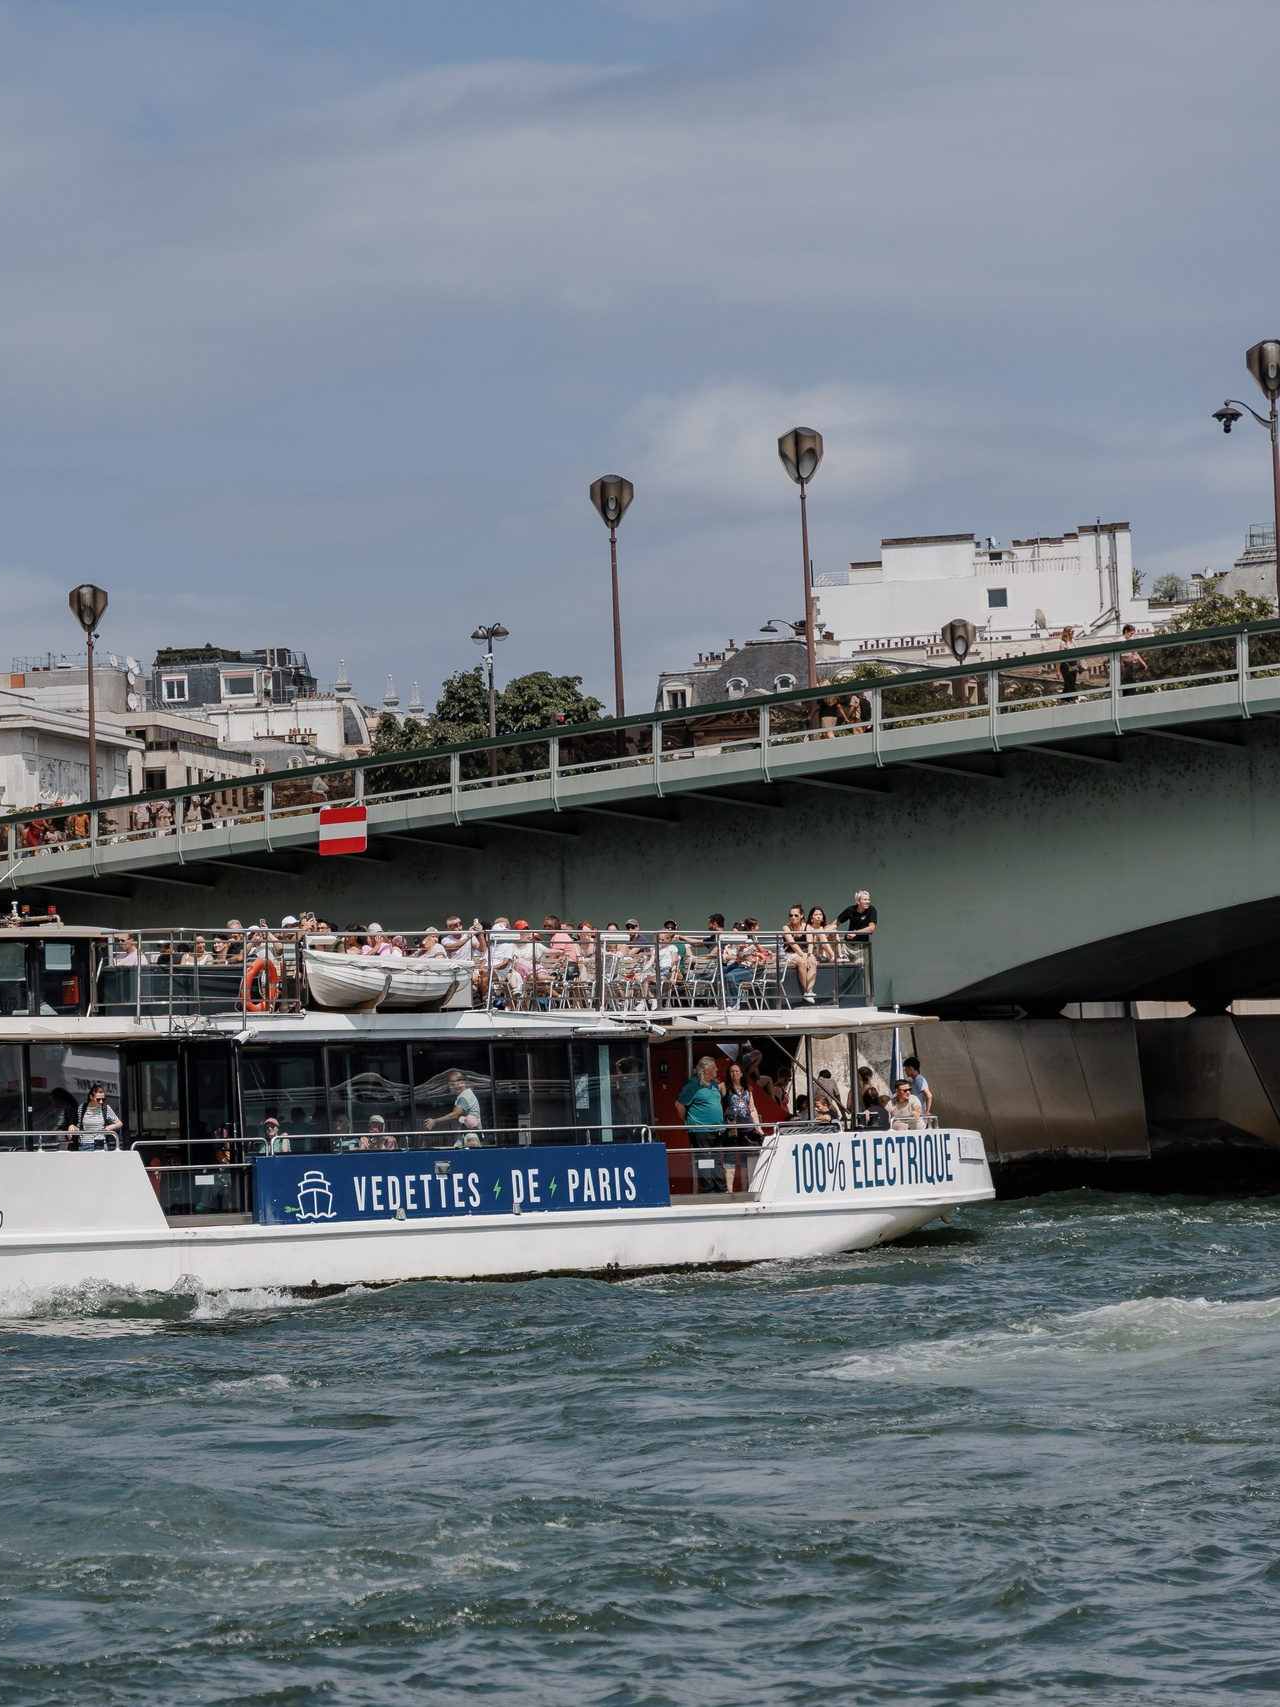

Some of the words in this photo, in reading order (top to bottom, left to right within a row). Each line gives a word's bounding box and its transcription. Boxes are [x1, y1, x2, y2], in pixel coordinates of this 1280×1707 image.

[353, 1172, 481, 1211] VEDETTES
[511, 1168, 541, 1204] DE
[567, 1166, 637, 1203] PARIS
[792, 1142, 846, 1193] 100%
[851, 1133, 953, 1189] ÉLECTRIQUE
